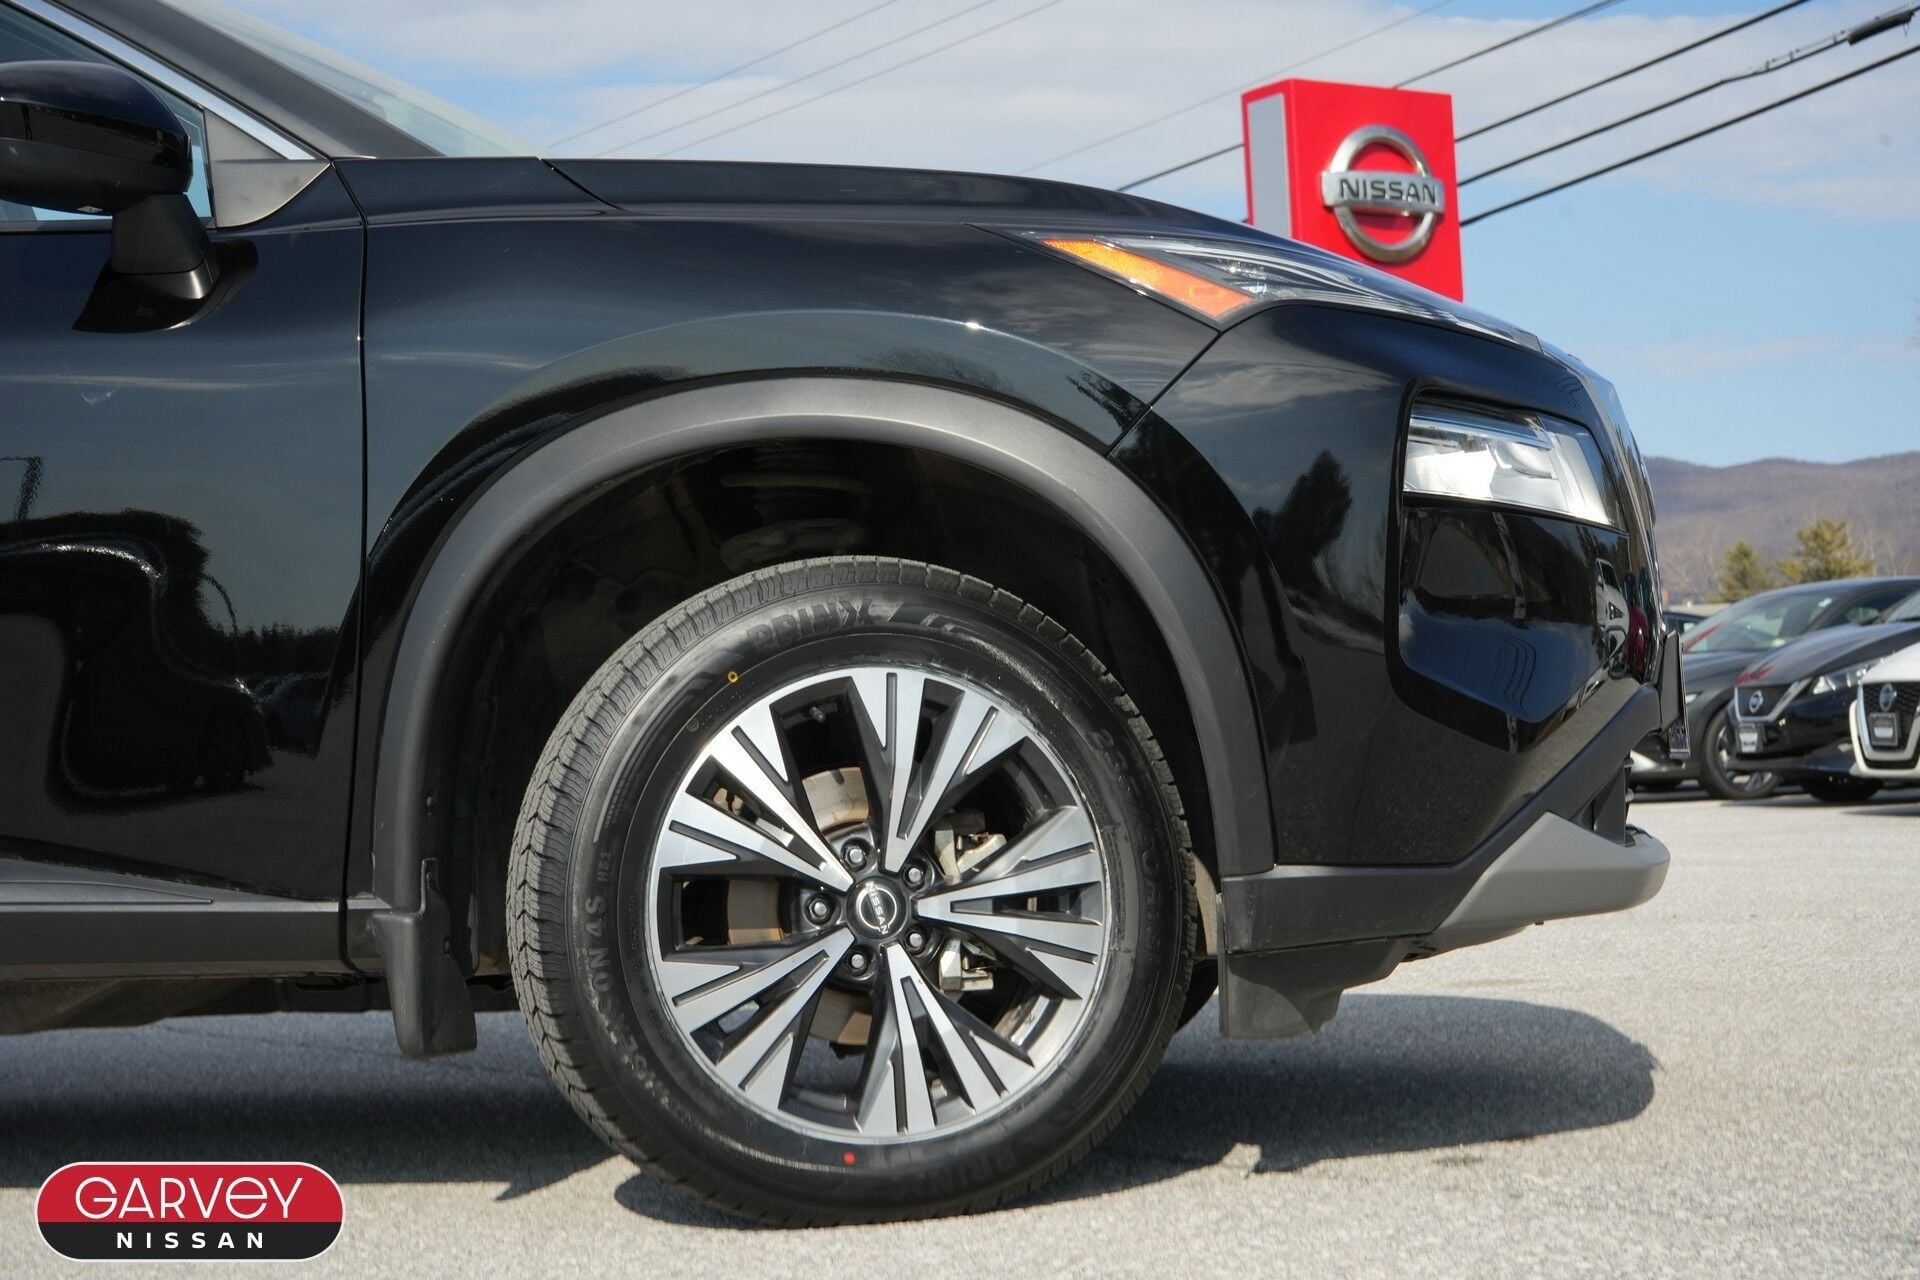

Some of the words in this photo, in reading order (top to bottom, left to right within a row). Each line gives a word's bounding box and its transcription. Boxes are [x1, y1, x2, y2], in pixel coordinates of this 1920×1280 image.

[1340, 178, 1436, 204] NISSAN
[747, 599, 875, 649] PRINX
[866, 881, 888, 934] NISSAN
